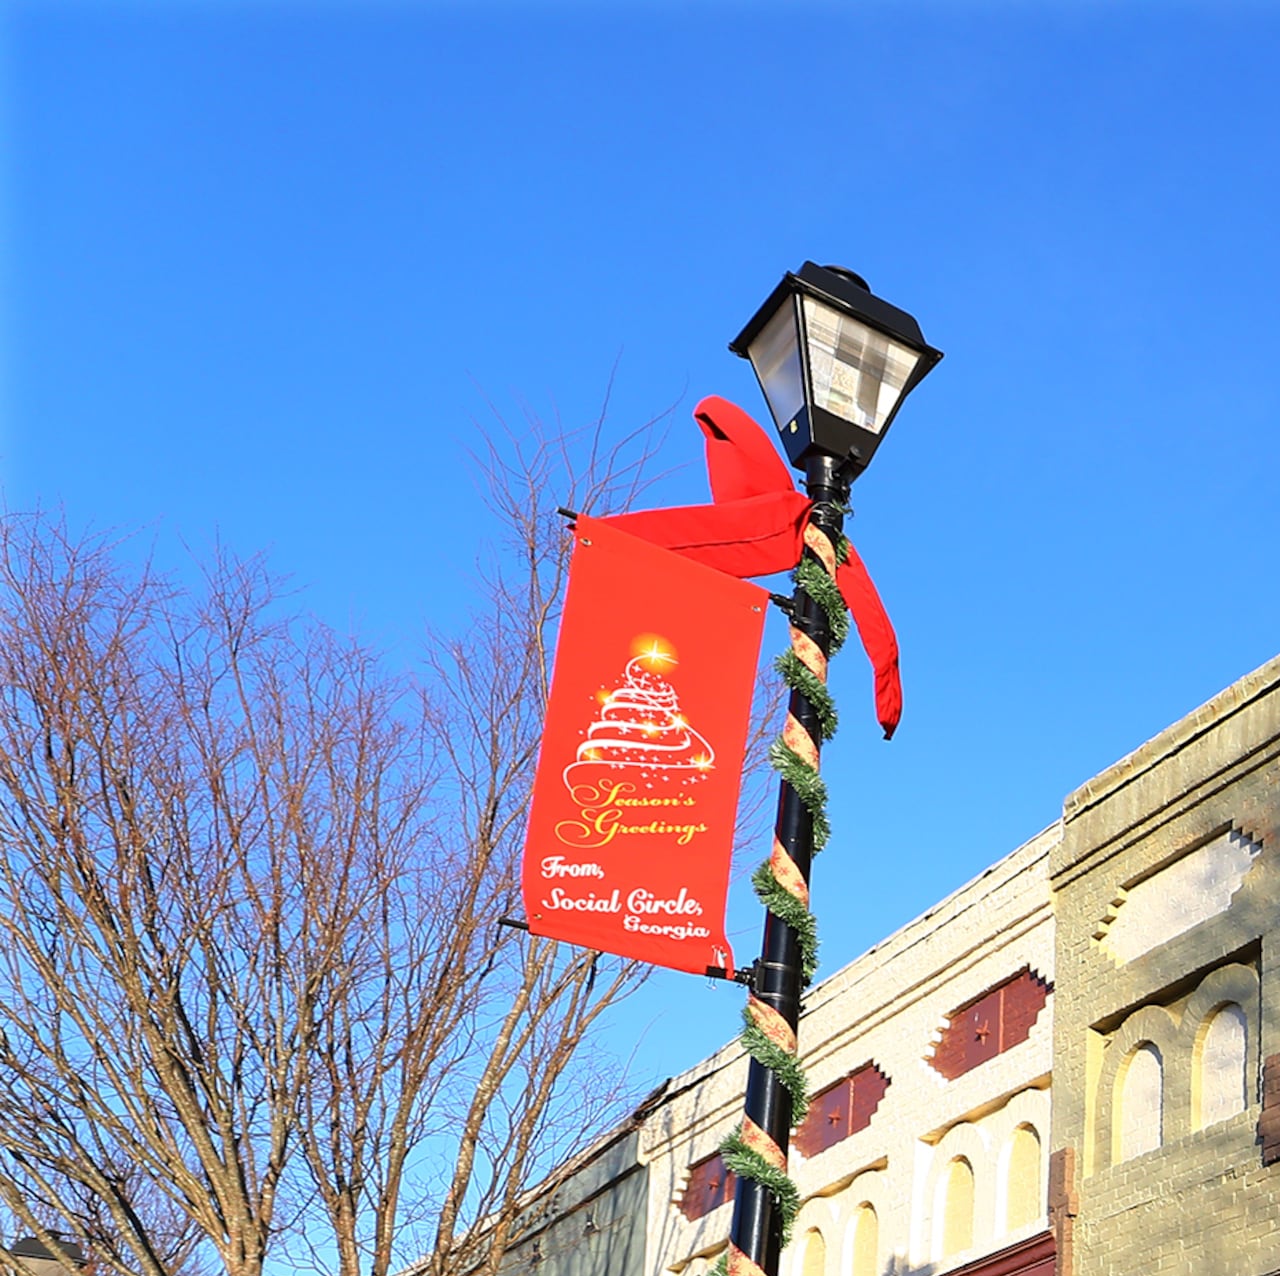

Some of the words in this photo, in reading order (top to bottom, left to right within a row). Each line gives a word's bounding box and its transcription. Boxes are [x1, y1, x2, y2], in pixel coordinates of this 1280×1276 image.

[571, 779, 696, 809] Season's
[555, 809, 709, 848] Greetings
[541, 856, 604, 878] From,
[542, 888, 622, 913] Social
[627, 888, 703, 915] Circle,
[623, 914, 710, 940] Georgia
